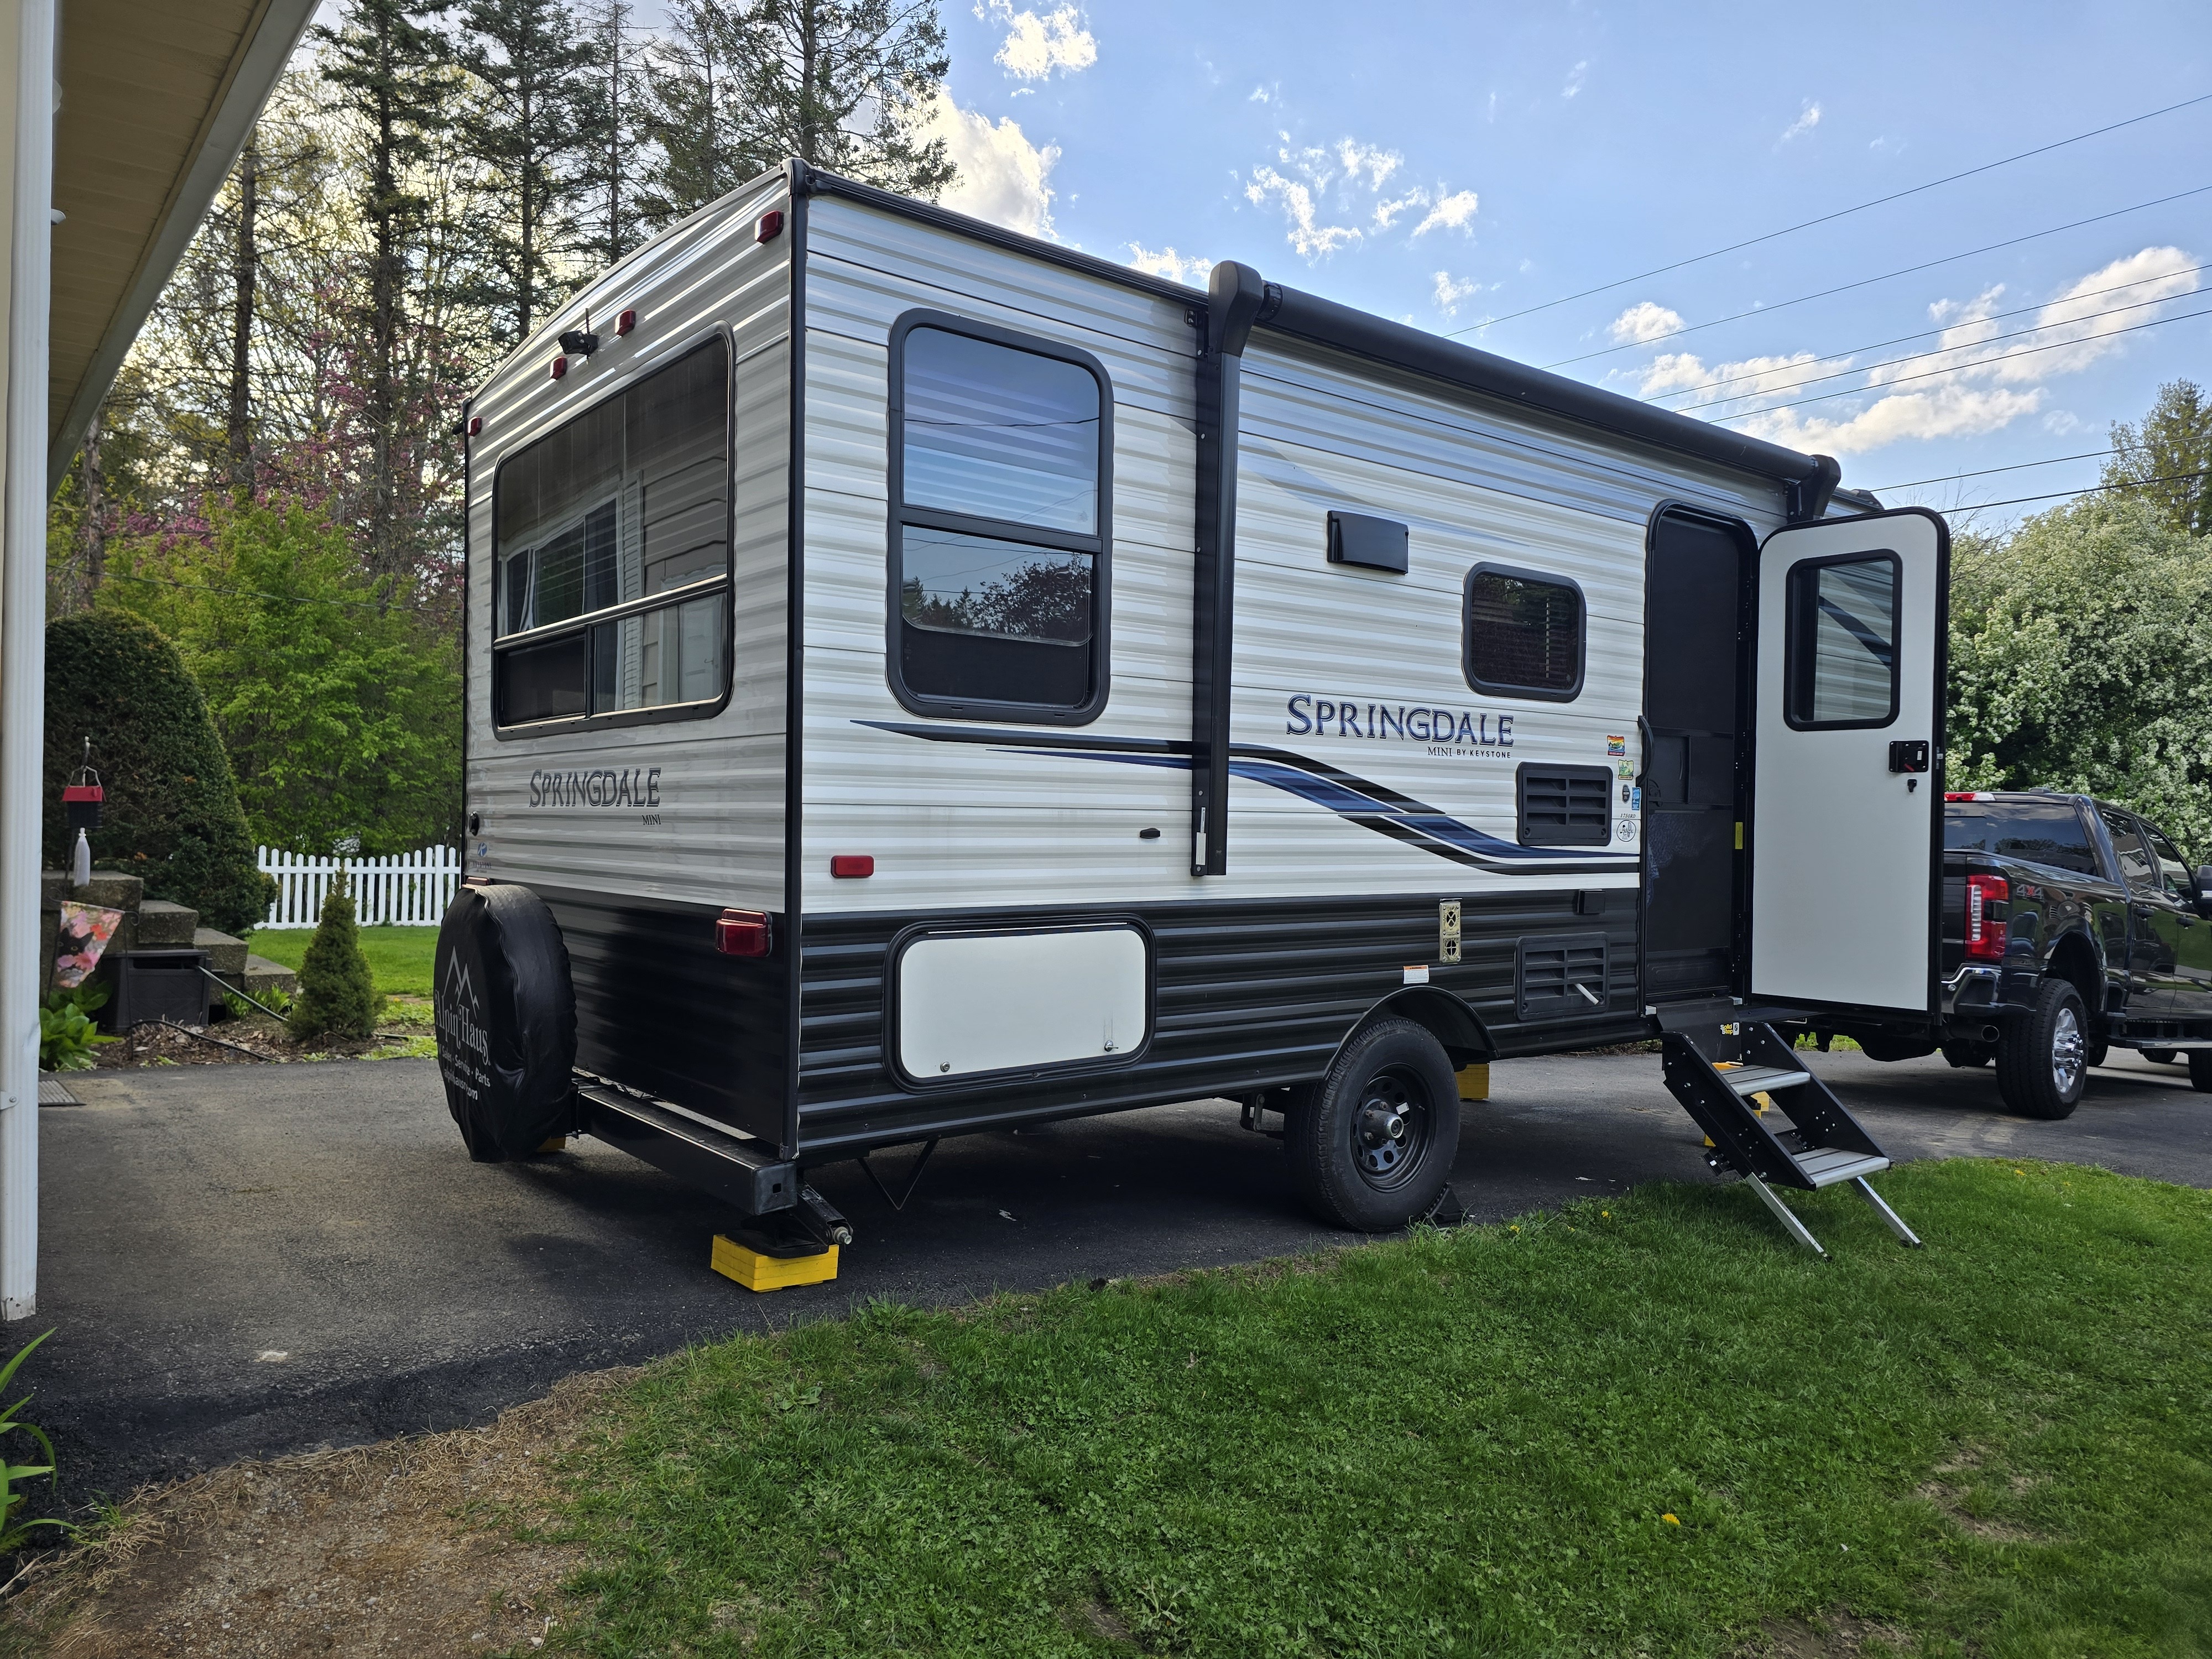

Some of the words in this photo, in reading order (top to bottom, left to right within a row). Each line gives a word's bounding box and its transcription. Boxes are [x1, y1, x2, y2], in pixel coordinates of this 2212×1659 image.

[1286, 694, 1514, 747] SPRINGDALE
[1427, 747, 1452, 757] MINI
[1470, 749, 1511, 758] KEYSTONE
[529, 767, 661, 807] SPRINGDALE
[641, 814, 662, 826] MINI
[434, 989, 461, 1050] Alpin
[458, 1004, 489, 1066] Haus
[475, 1067, 491, 1087] Parts
